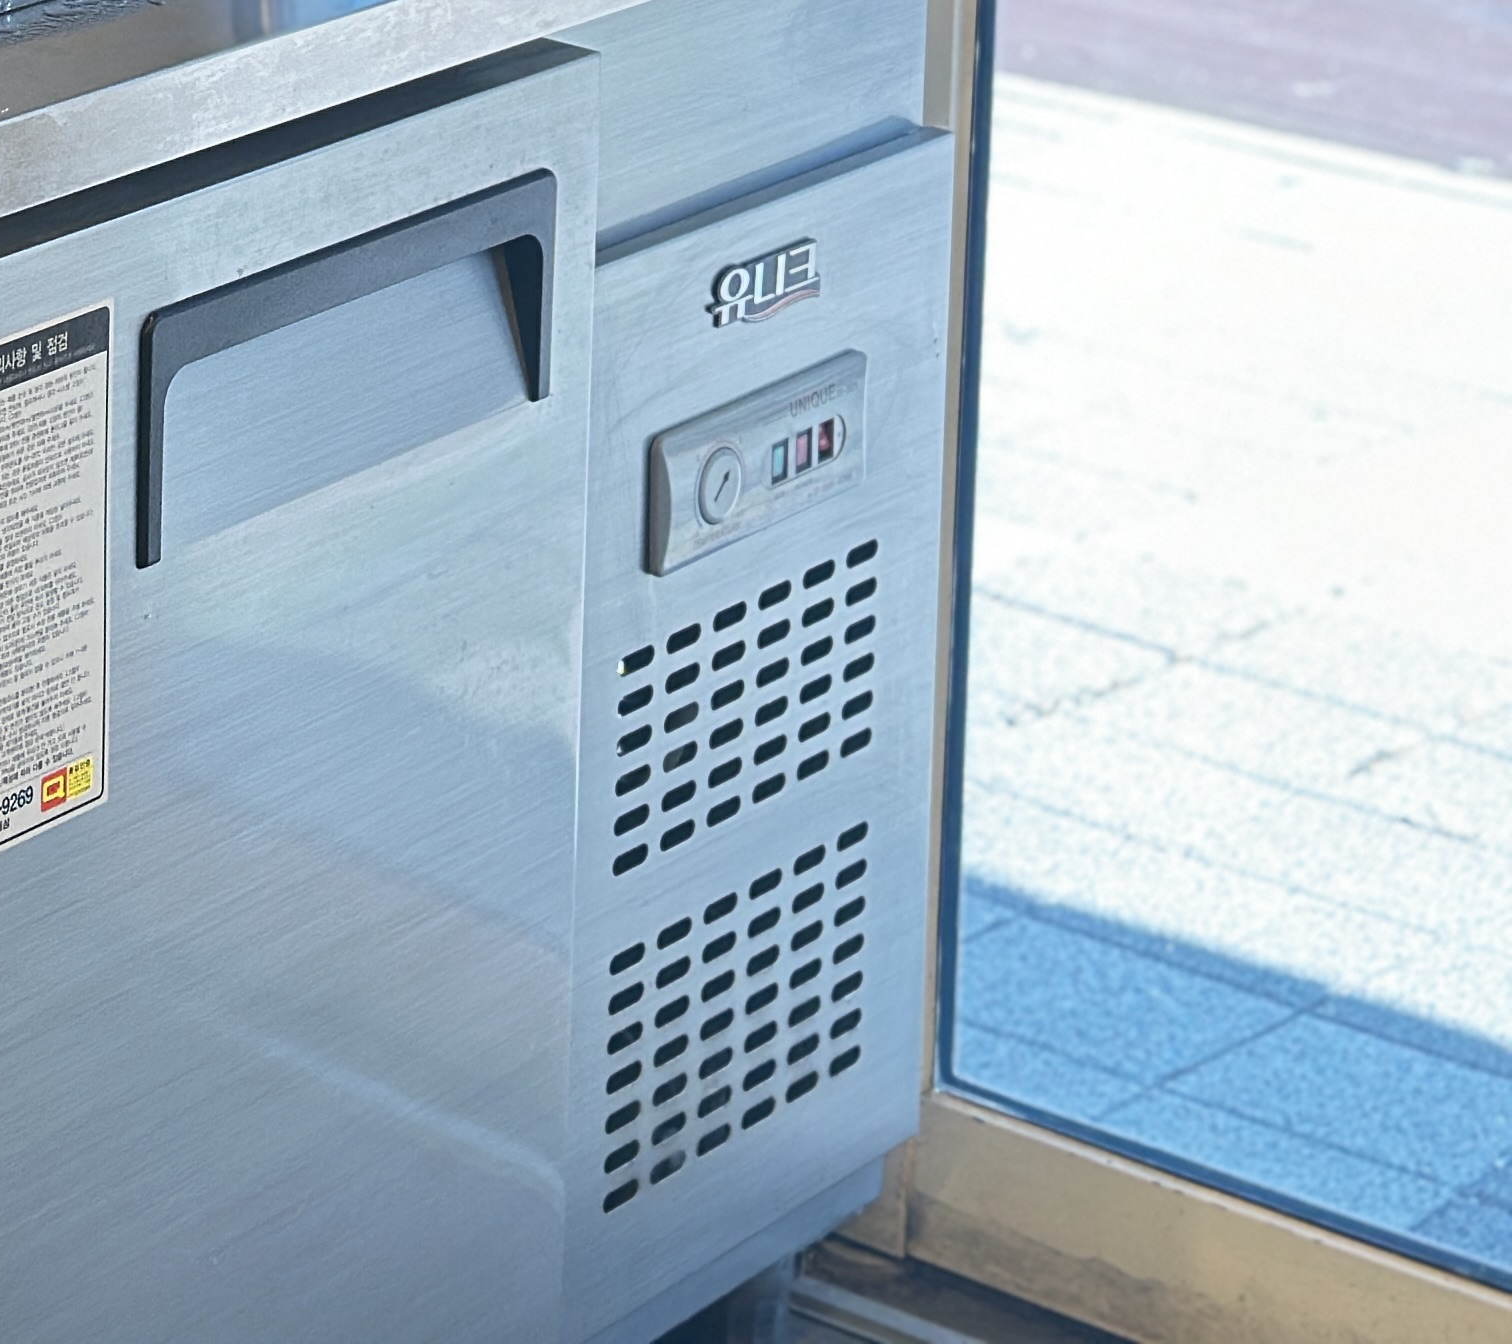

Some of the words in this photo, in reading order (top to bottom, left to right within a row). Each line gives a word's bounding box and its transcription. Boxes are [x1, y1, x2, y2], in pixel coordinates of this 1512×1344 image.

[715, 242, 819, 325] 유니크
[31, 341, 42, 362] 및
[47, 331, 68, 355] 점검
[789, 383, 836, 417] UNIQUE
